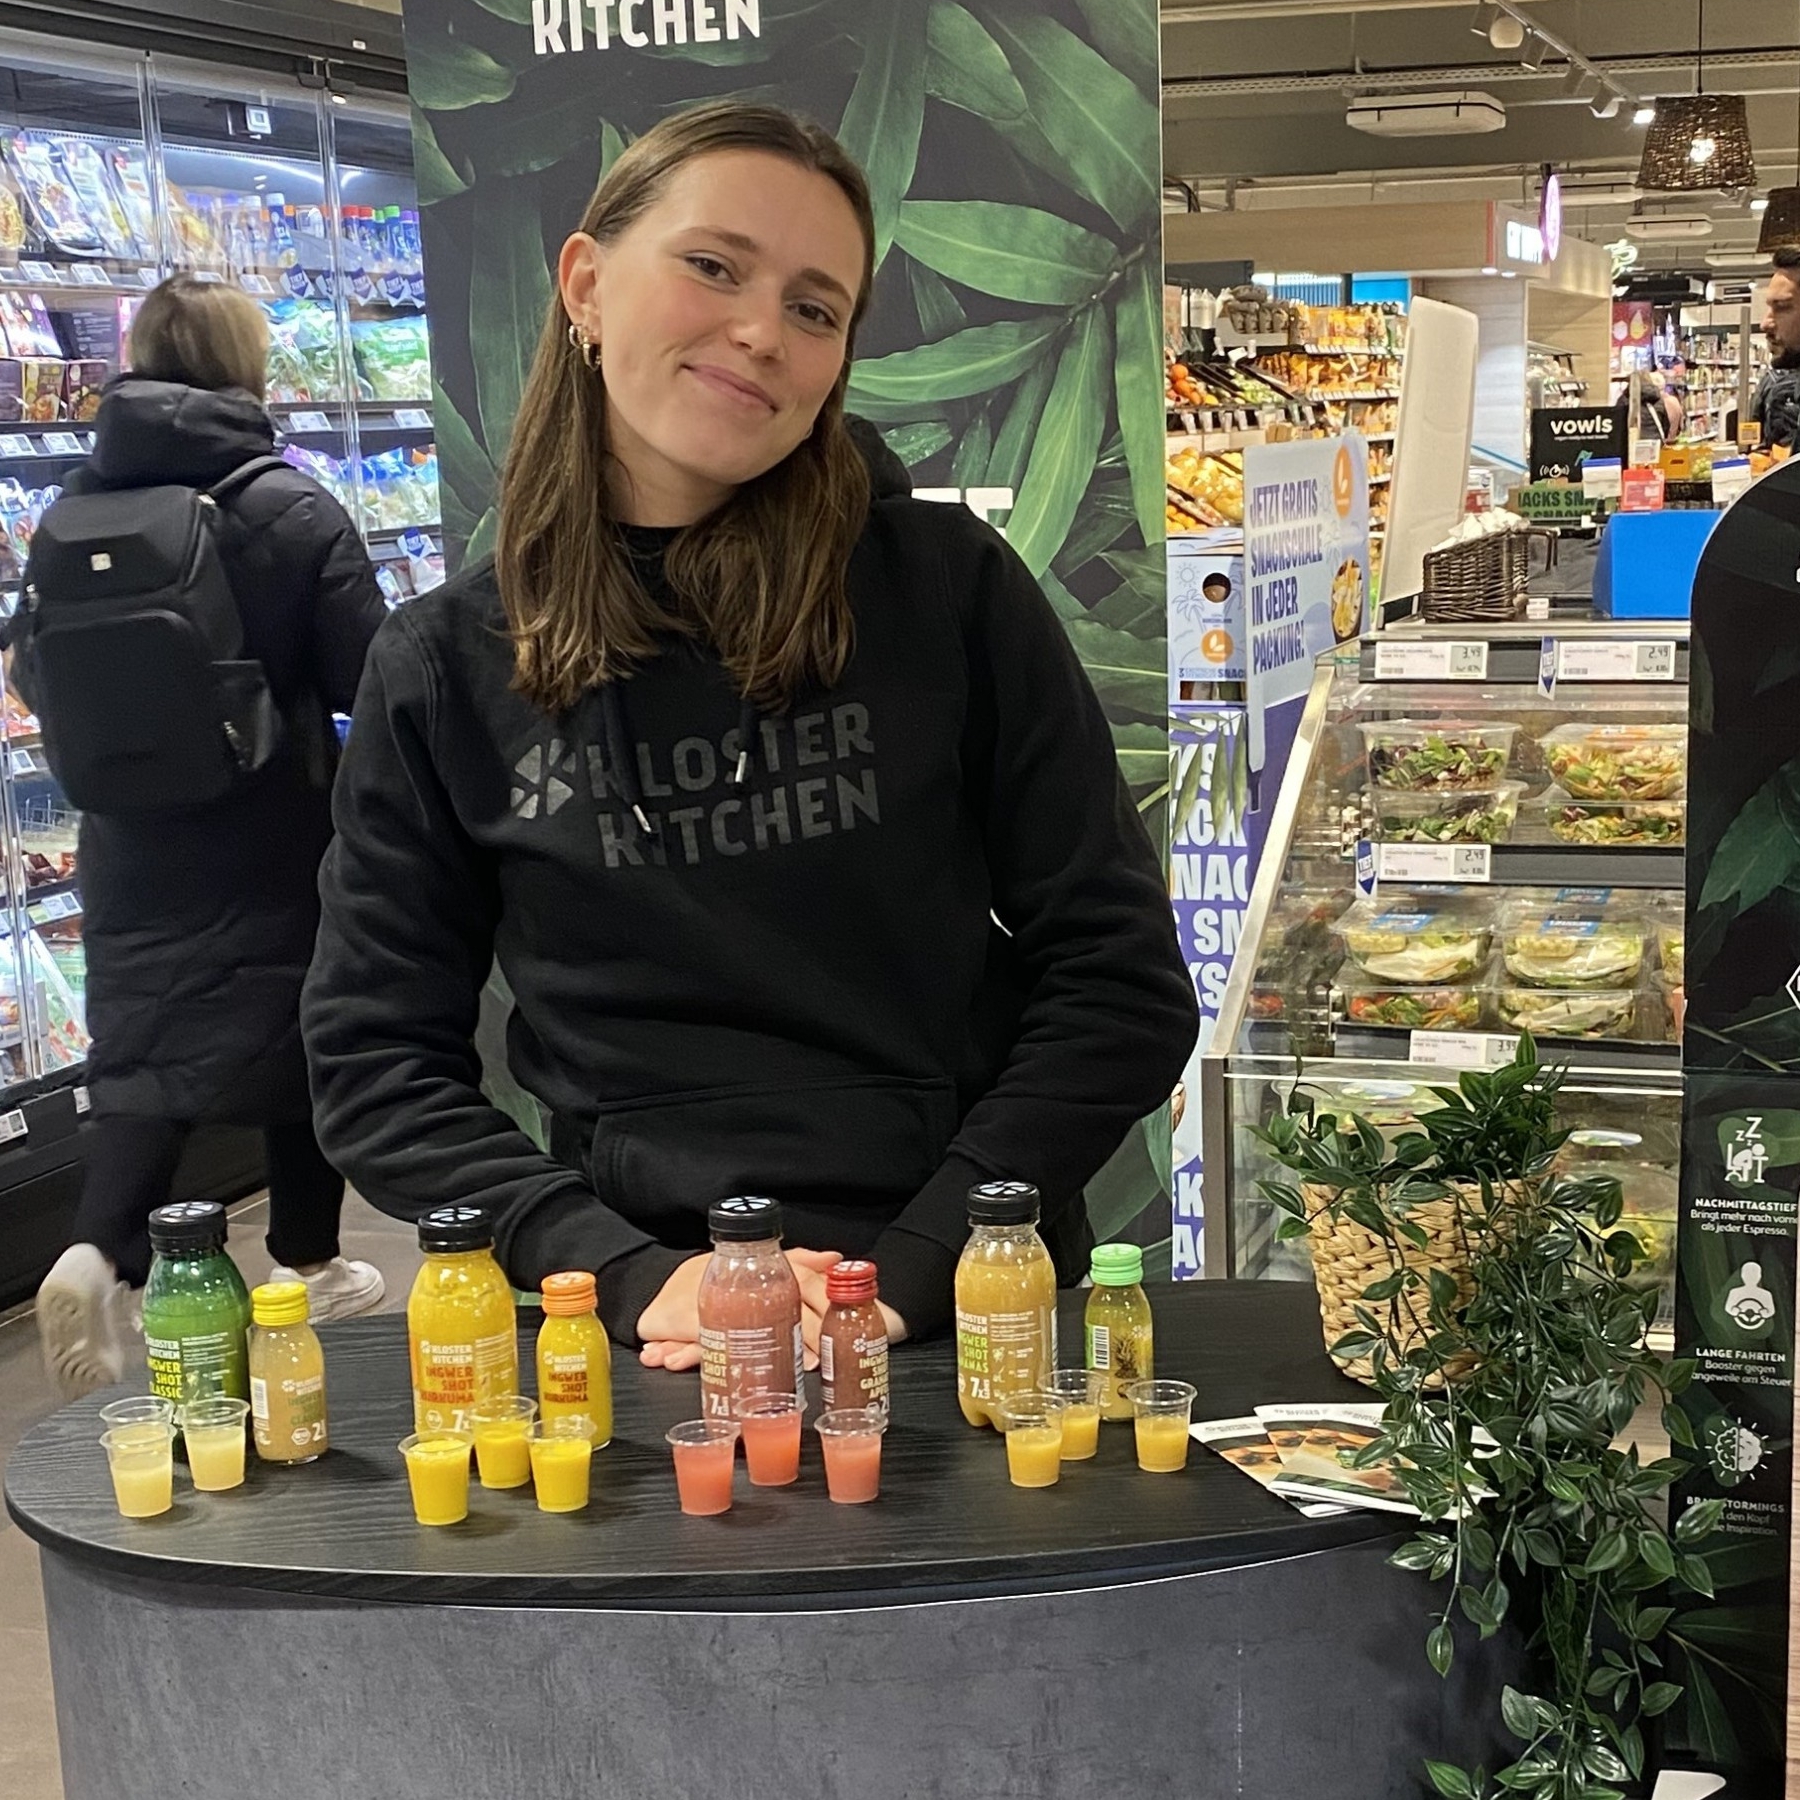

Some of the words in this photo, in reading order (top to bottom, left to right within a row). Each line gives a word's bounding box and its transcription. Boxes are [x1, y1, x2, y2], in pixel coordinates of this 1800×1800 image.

[531, 0, 761, 54] KITCHEN
[1550, 414, 1613, 435] vowls
[1250, 484, 1280, 529] JETZT
[1282, 478, 1318, 522] GRATIS
[1251, 523, 1323, 578] SNACKSCHALE
[1252, 584, 1264, 627] IN
[1265, 576, 1299, 622] JEDER
[1253, 619, 1305, 675] PACKUNG!
[1218, 668, 1247, 679] SNAC
[587, 702, 875, 799] KLOSTER
[597, 768, 882, 869] KITCHEN
[1690, 1208, 1720, 1222] Bringt
[1721, 1212, 1748, 1222] mehr
[1748, 1214, 1772, 1223] nach
[1701, 1222, 1715, 1232] als
[1715, 1223, 1742, 1234] jeder
[1743, 1224, 1789, 1237] Espresso.
[964, 1346, 988, 1361] SHOT
[1696, 1348, 1733, 1359] LANGE
[1735, 1350, 1787, 1362] FAHRTEN
[426, 1367, 474, 1379] INGWER
[1705, 1360, 1743, 1371] Booster
[1744, 1364, 1776, 1375] gegen
[155, 1371, 182, 1386] SHOT
[441, 1379, 475, 1391] SHOT
[1691, 1372, 1741, 1384] angeweile
[1742, 1376, 1759, 1384] am
[561, 1382, 588, 1393] SHOT
[1726, 1511, 1745, 1521] den
[1747, 1513, 1771, 1525] Kopf
